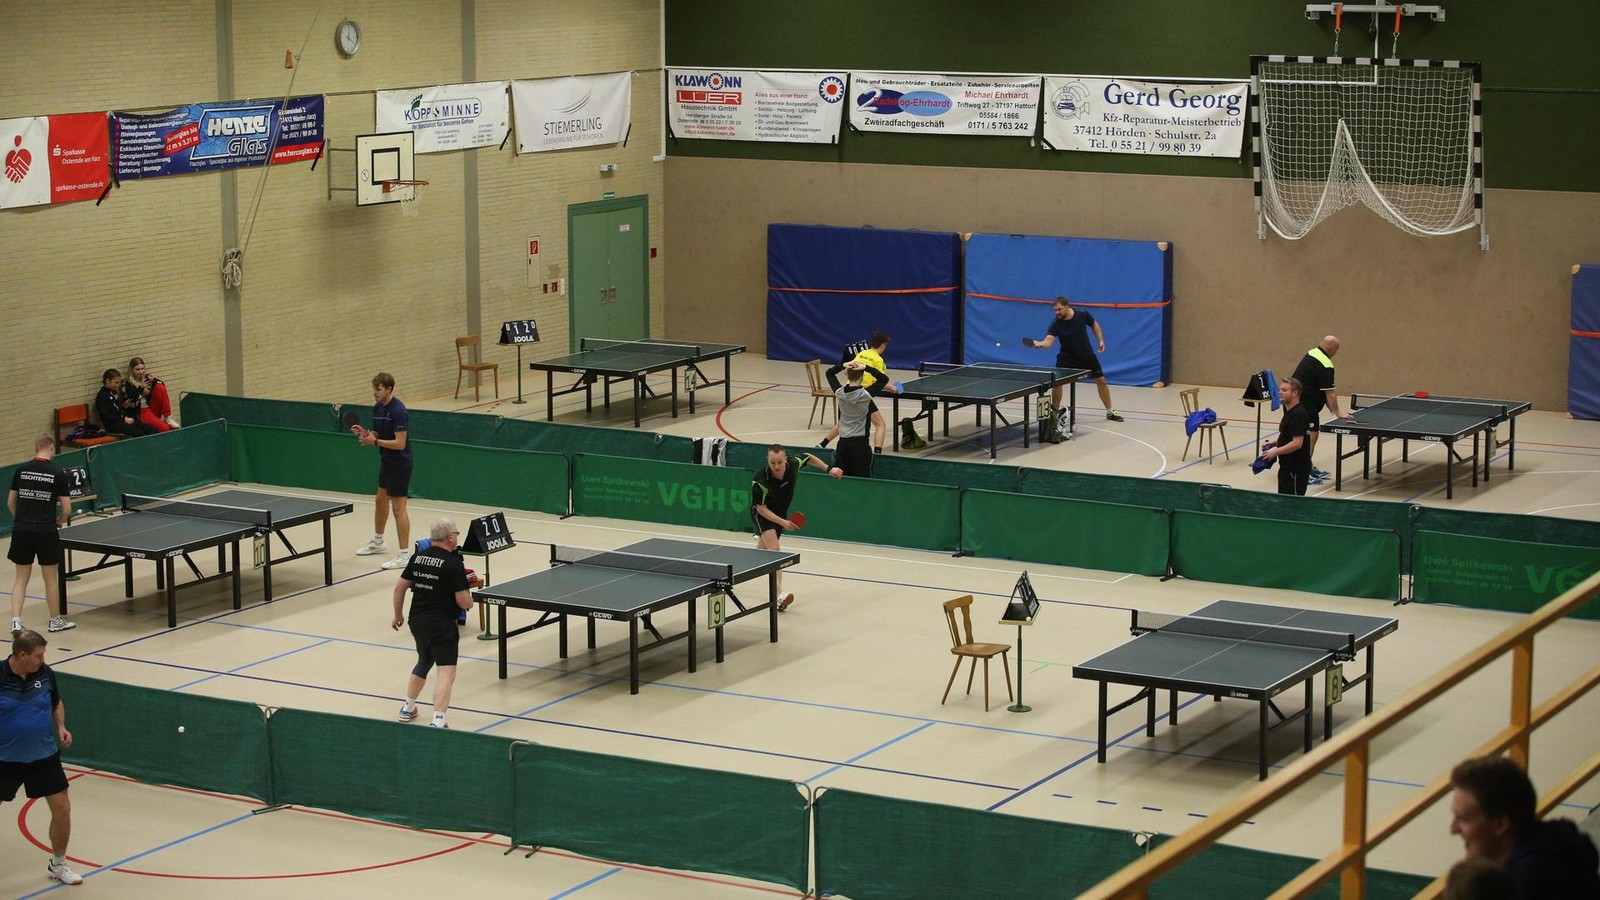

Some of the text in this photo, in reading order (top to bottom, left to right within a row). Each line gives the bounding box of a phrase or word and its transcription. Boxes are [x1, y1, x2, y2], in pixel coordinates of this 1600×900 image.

[675, 73, 741, 90] KLAWONN
[995, 91, 1029, 99] Ehrhardt
[1104, 83, 1242, 116] Gerd Georg
[442, 103, 479, 117] MINNE
[544, 117, 602, 135] STIEMERLING
[864, 117, 945, 129] Zweiradfachgeschäft
[968, 121, 985, 129] 0171
[991, 122, 997, 130] 5
[998, 122, 1013, 130] 763
[1014, 122, 1029, 130] 242
[1103, 113, 1242, 128] Kfz-Reparatur-Meisterbetrieb
[1073, 126, 1216, 140] 37412 Hörden Schulstr. 2a
[62, 149, 86, 157] Sparkasse
[227, 137, 269, 157] Glas
[1088, 138, 1108, 149] Tel.
[1111, 140, 1117, 149] 0
[1120, 140, 1132, 150] 55
[1135, 141, 1146, 151] 21
[1159, 142, 1170, 152] 99
[1173, 143, 1186, 153] 80
[1189, 143, 1201, 153] 39
[514, 335, 535, 343] JOOLA
[1038, 400, 1050, 419] 13
[582, 475, 649, 488] Uwe Spitkowski
[657, 481, 726, 513] VGH
[486, 536, 508, 551] JOOLA
[414, 555, 445, 568] BUTTERFLY
[1424, 556, 1513, 571] Uwe Spitkowski
[713, 600, 721, 625] 9
[1331, 675, 1339, 701] 8
